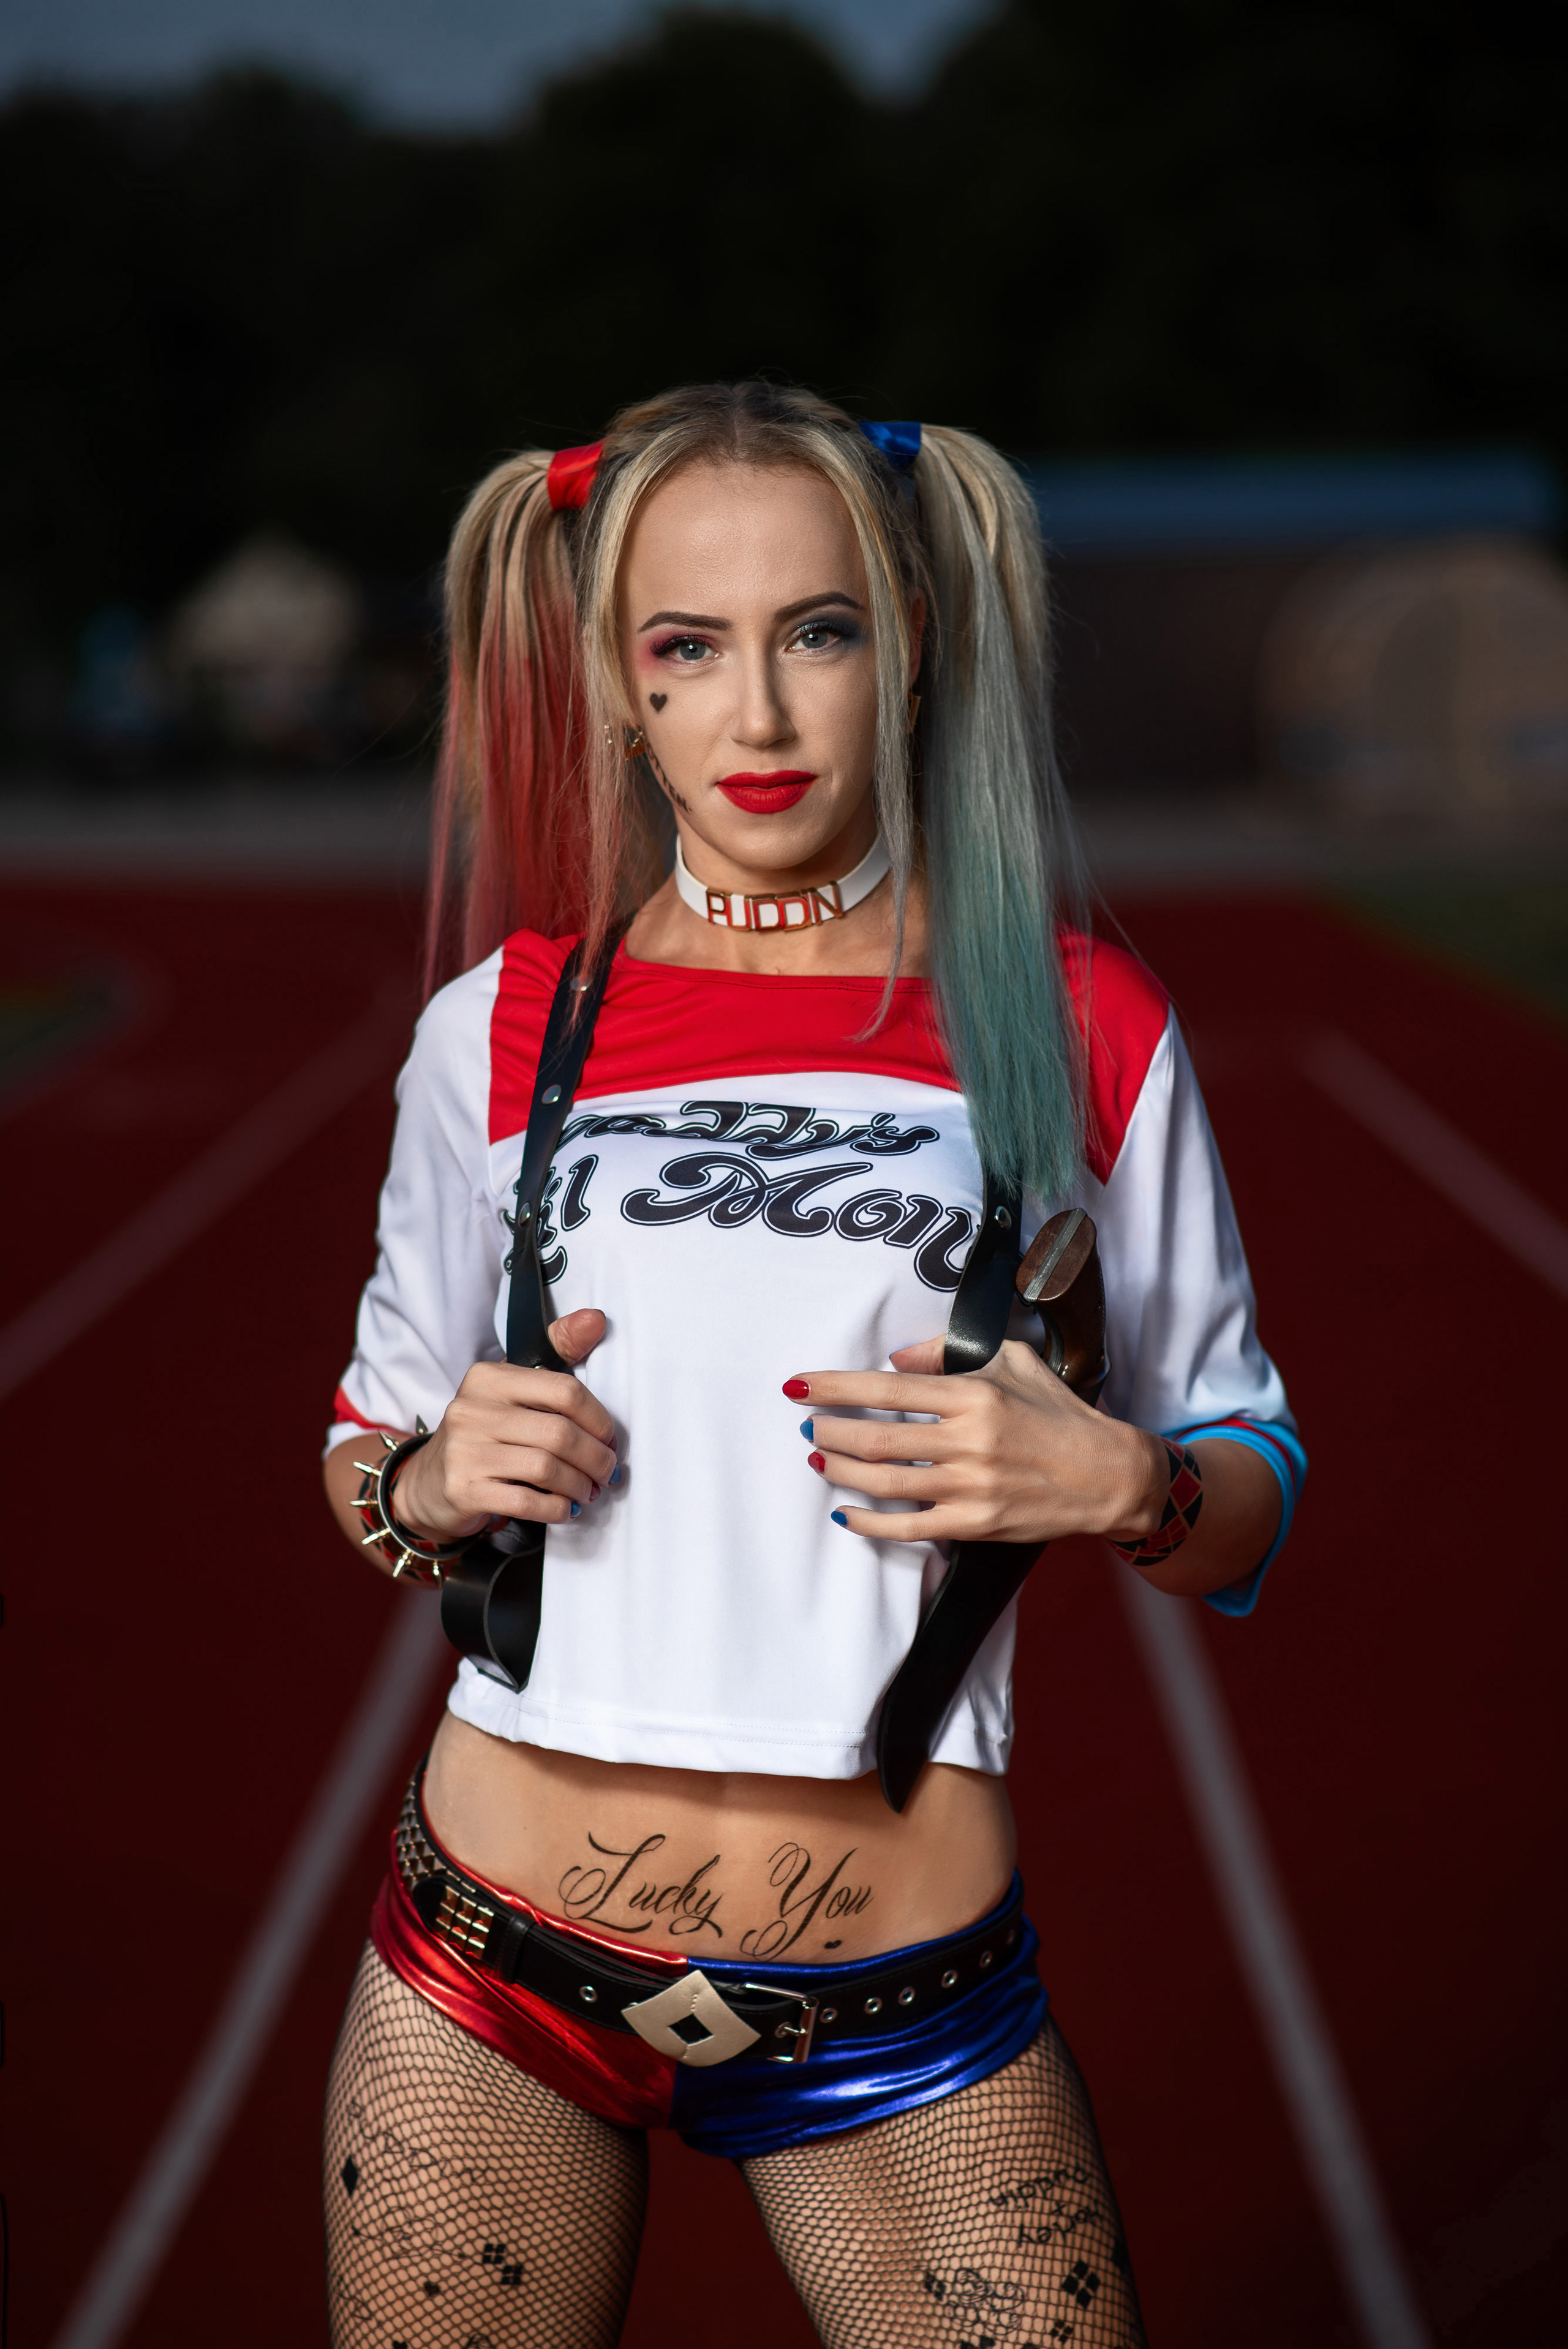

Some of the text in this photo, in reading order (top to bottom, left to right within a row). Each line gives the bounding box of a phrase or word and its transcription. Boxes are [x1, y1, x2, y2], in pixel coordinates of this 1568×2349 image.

[620, 1152, 980, 1292] Mon
[559, 1831, 875, 1961] Lucky You
